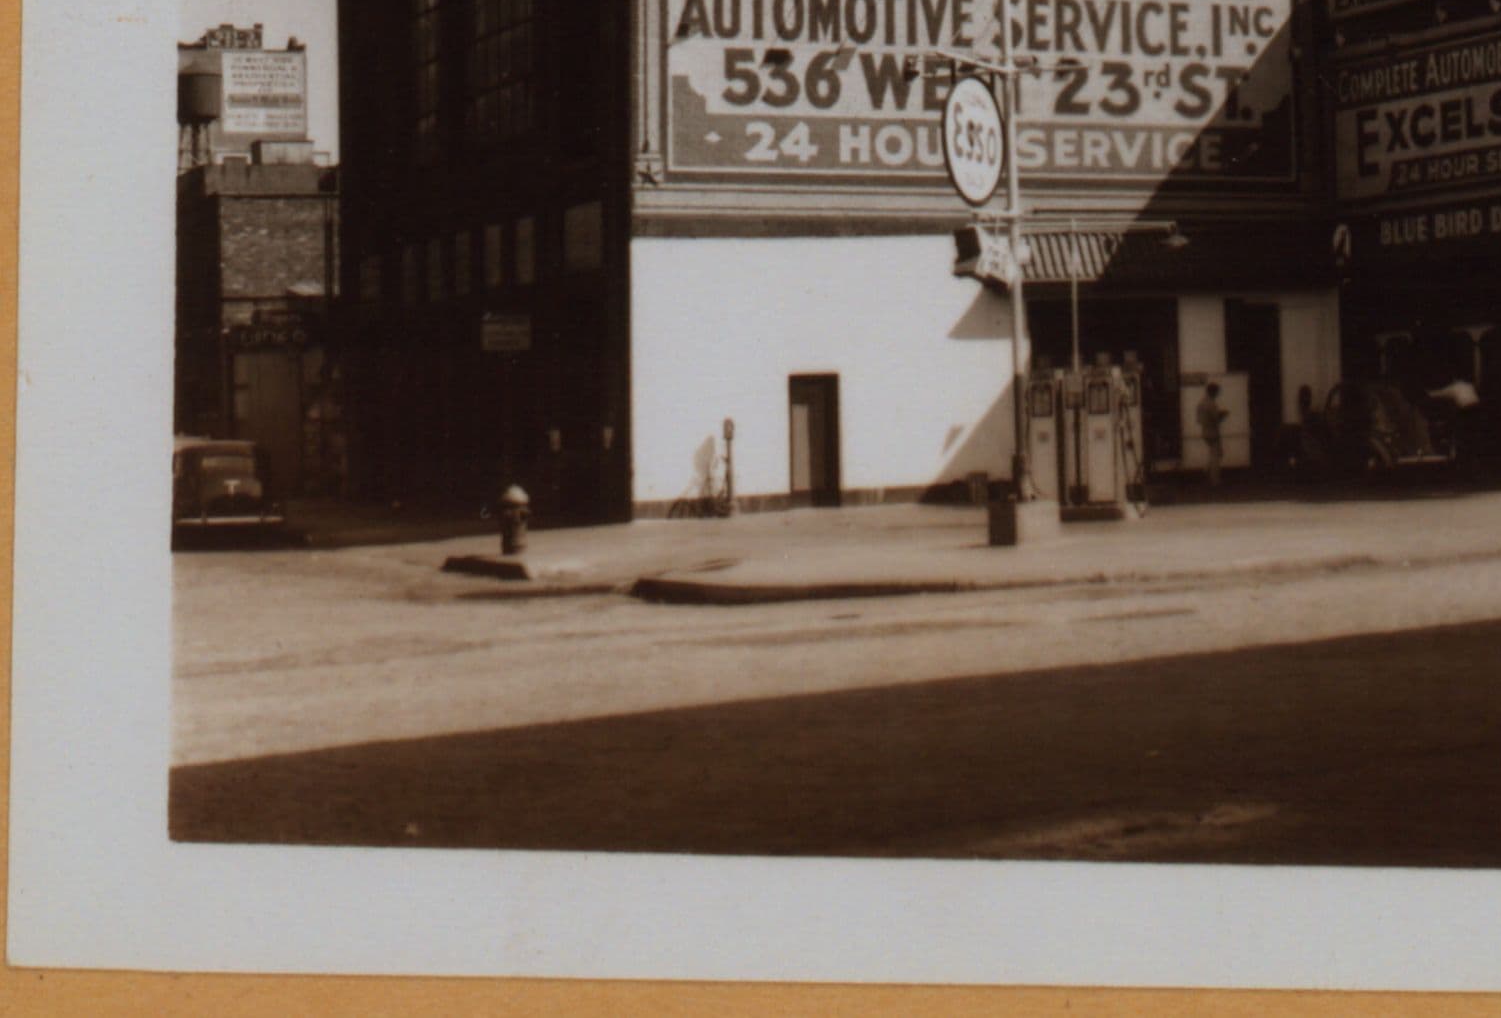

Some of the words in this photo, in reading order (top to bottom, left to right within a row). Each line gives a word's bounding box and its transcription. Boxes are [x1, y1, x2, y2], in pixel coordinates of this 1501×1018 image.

[721, 47, 841, 110] 536
[859, 51, 1022, 114] WE
[1337, 59, 1419, 103] COMPLETE
[745, 120, 819, 163] 24
[839, 124, 948, 167] HOU
[1016, 128, 1223, 170] SERVICE
[1427, 154, 1480, 182] HOUR
[1379, 214, 1429, 246] BLUE
[1433, 207, 1483, 239] BIRD
